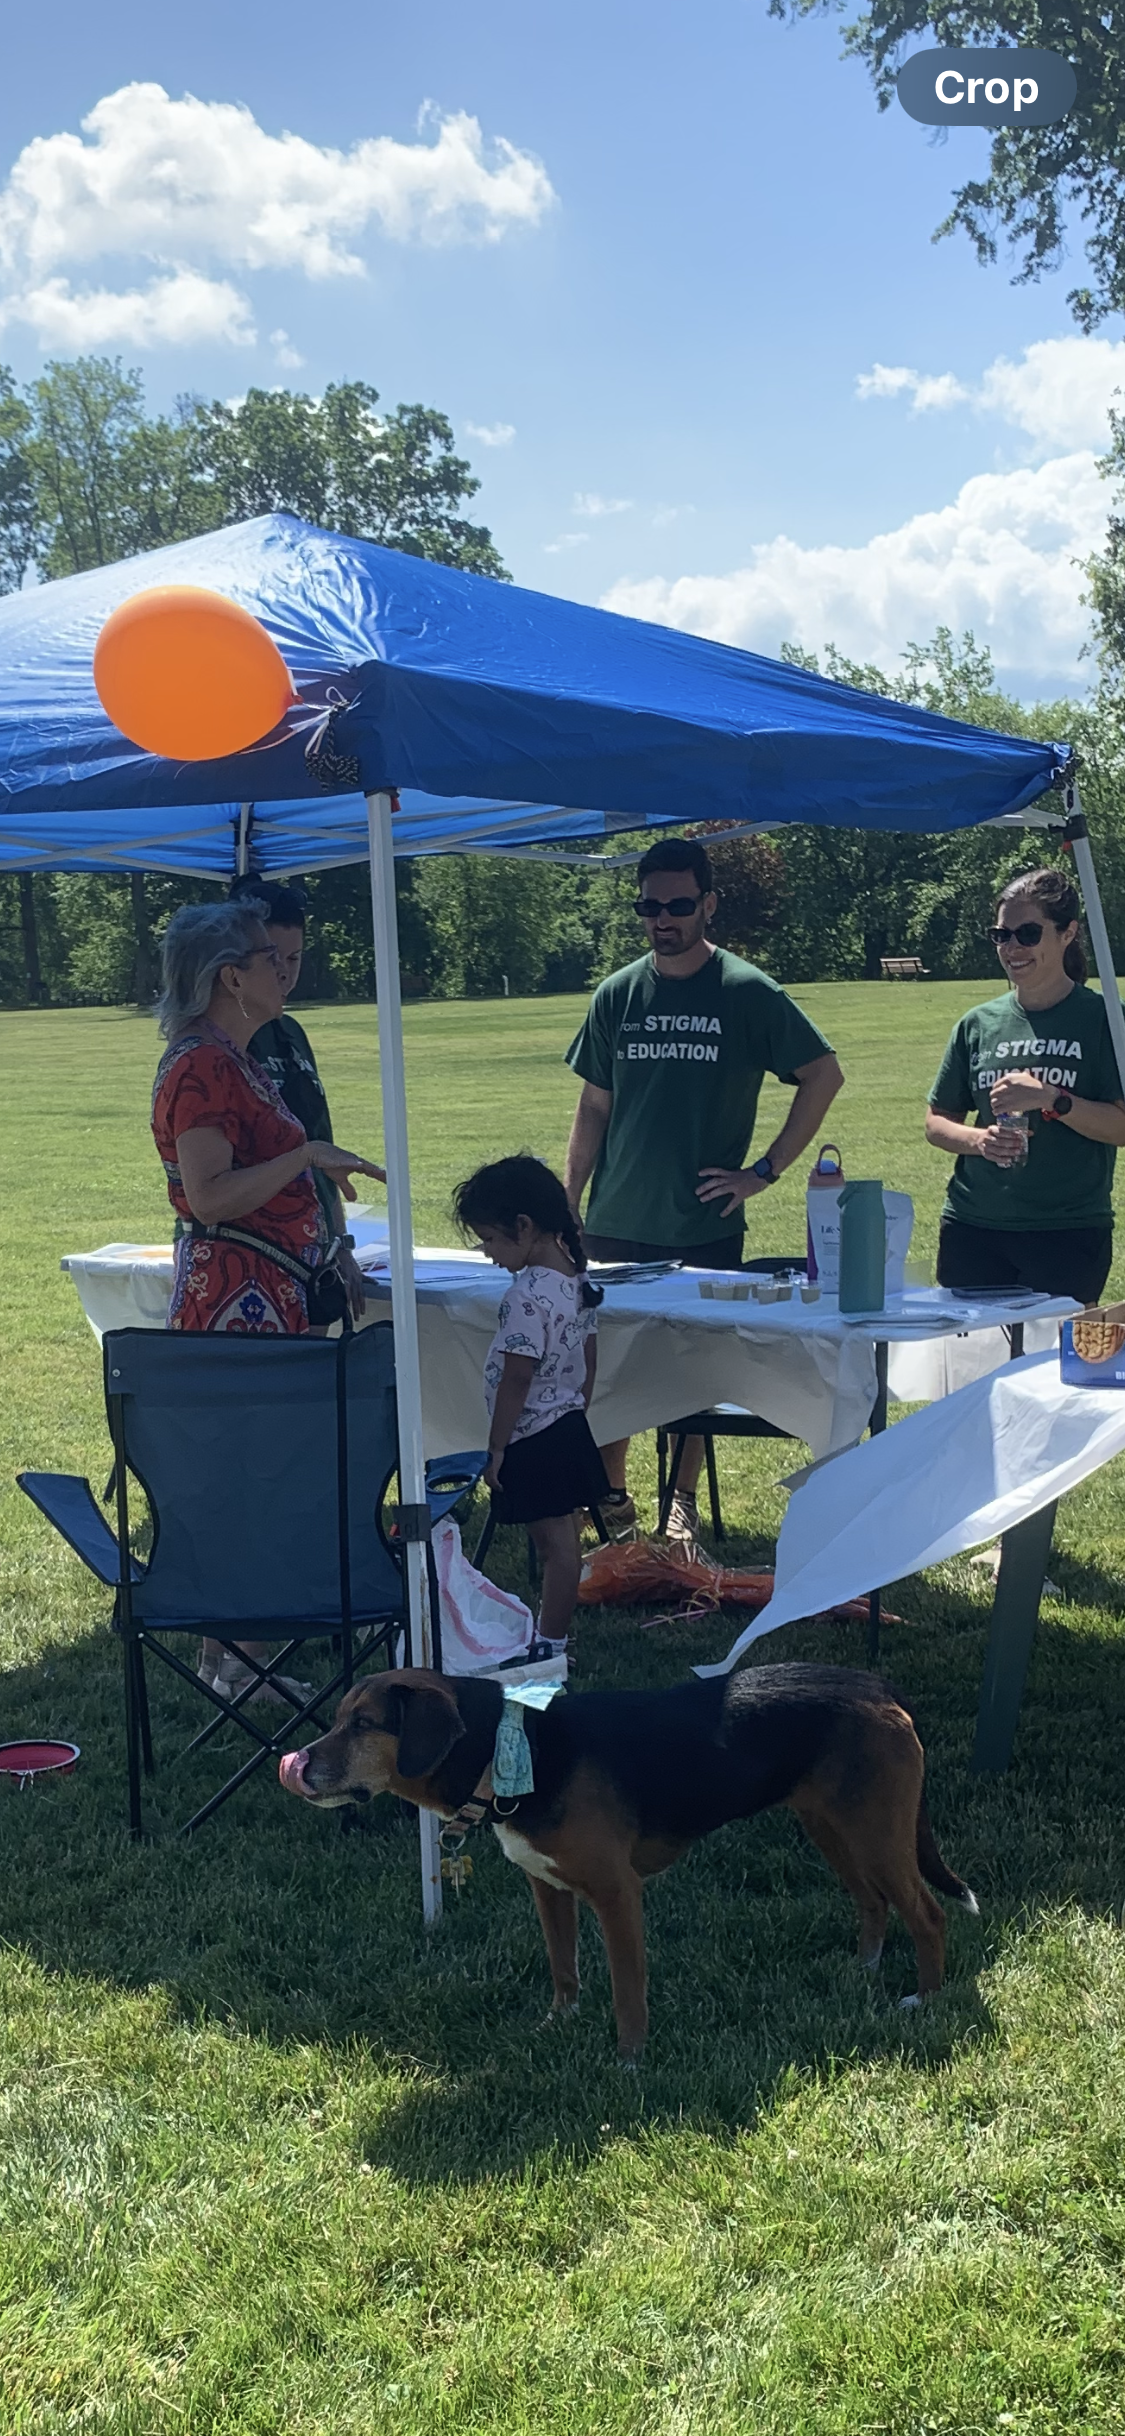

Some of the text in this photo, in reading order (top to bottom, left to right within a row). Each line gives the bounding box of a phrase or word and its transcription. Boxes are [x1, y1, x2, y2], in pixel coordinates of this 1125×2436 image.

[619, 1015, 722, 1035] rom STIGMA
[617, 1043, 719, 1062] to EDUCATION
[995, 1039, 1082, 1060] STIGMA
[978, 1067, 1077, 1088] EDTION
